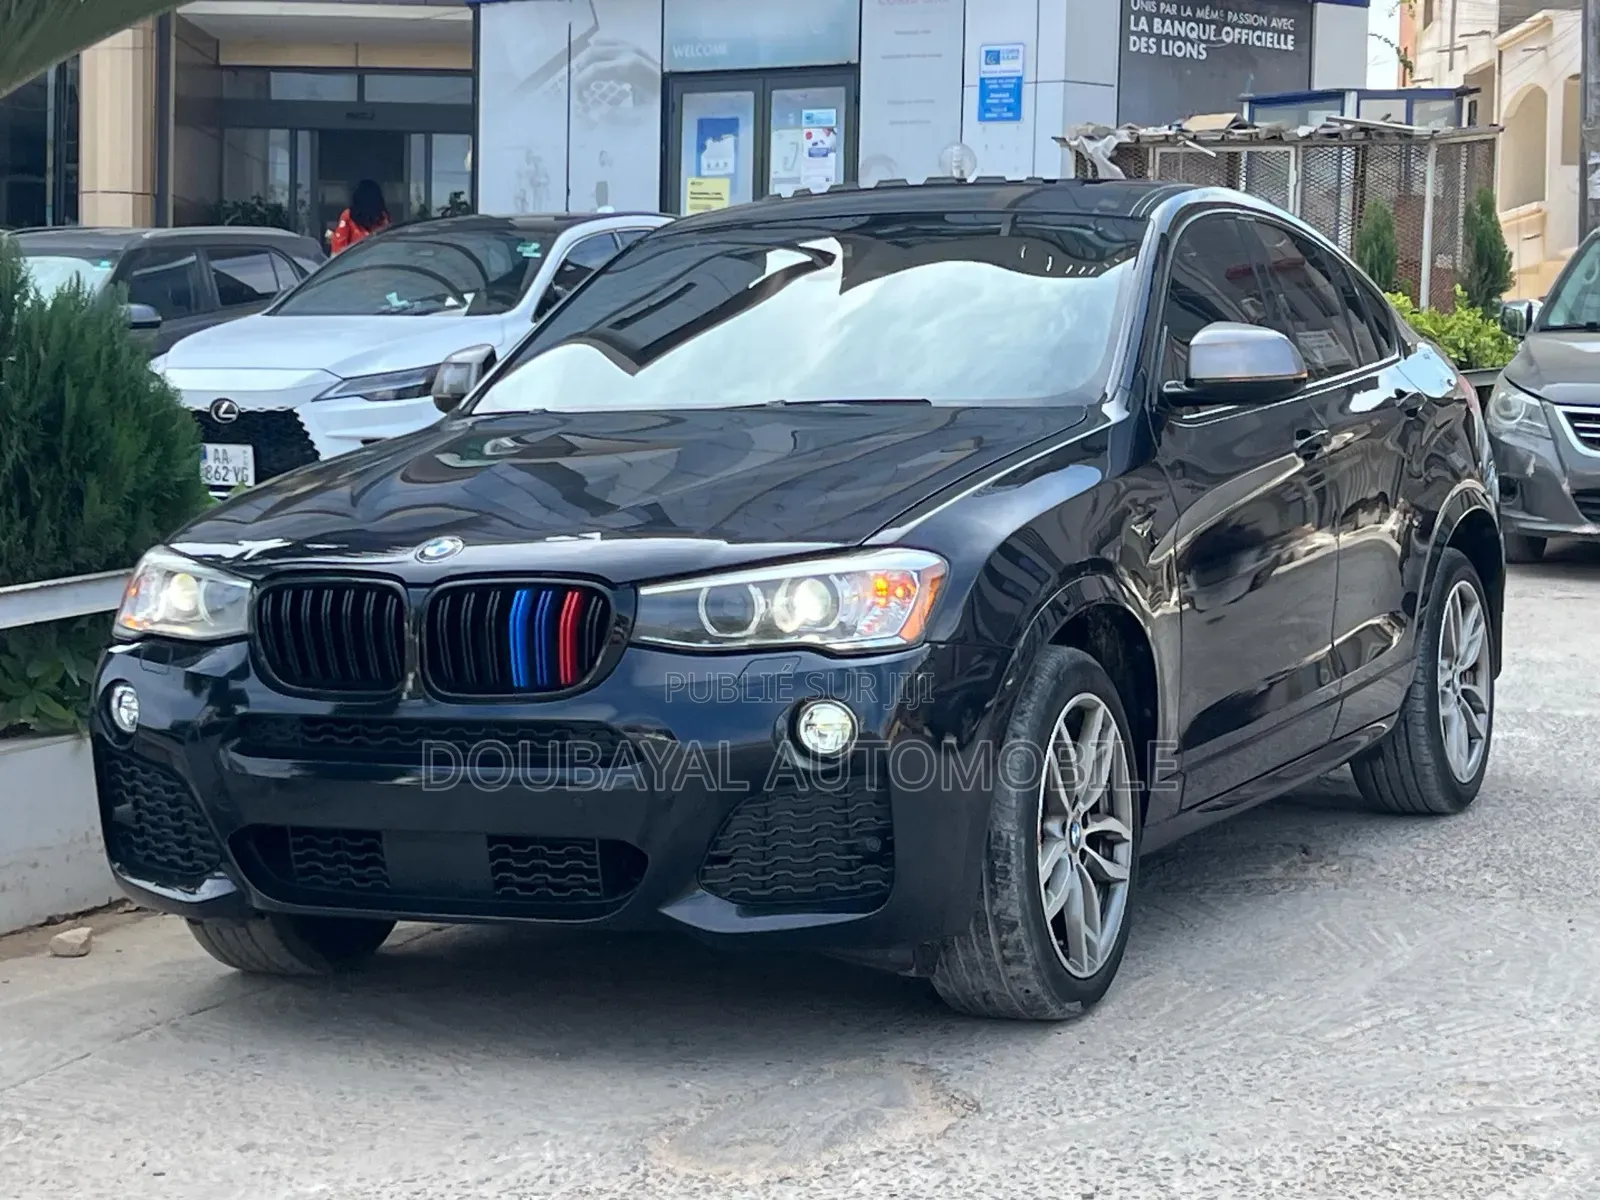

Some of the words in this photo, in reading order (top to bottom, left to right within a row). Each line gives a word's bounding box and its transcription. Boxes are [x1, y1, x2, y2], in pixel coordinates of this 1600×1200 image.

[1131, 0, 1157, 13] UNIS
[1160, 2, 1177, 15] PAR
[1180, 5, 1193, 17] LA
[1227, 11, 1268, 27] PASSION
[1270, 17, 1295, 31] AVEC
[1129, 35, 1157, 54] DES
[1161, 39, 1207, 60] LIONS
[1130, 15, 1149, 33] LA
[1153, 17, 1217, 41] BANQUE
[1222, 26, 1295, 51] OFFICIELLE
